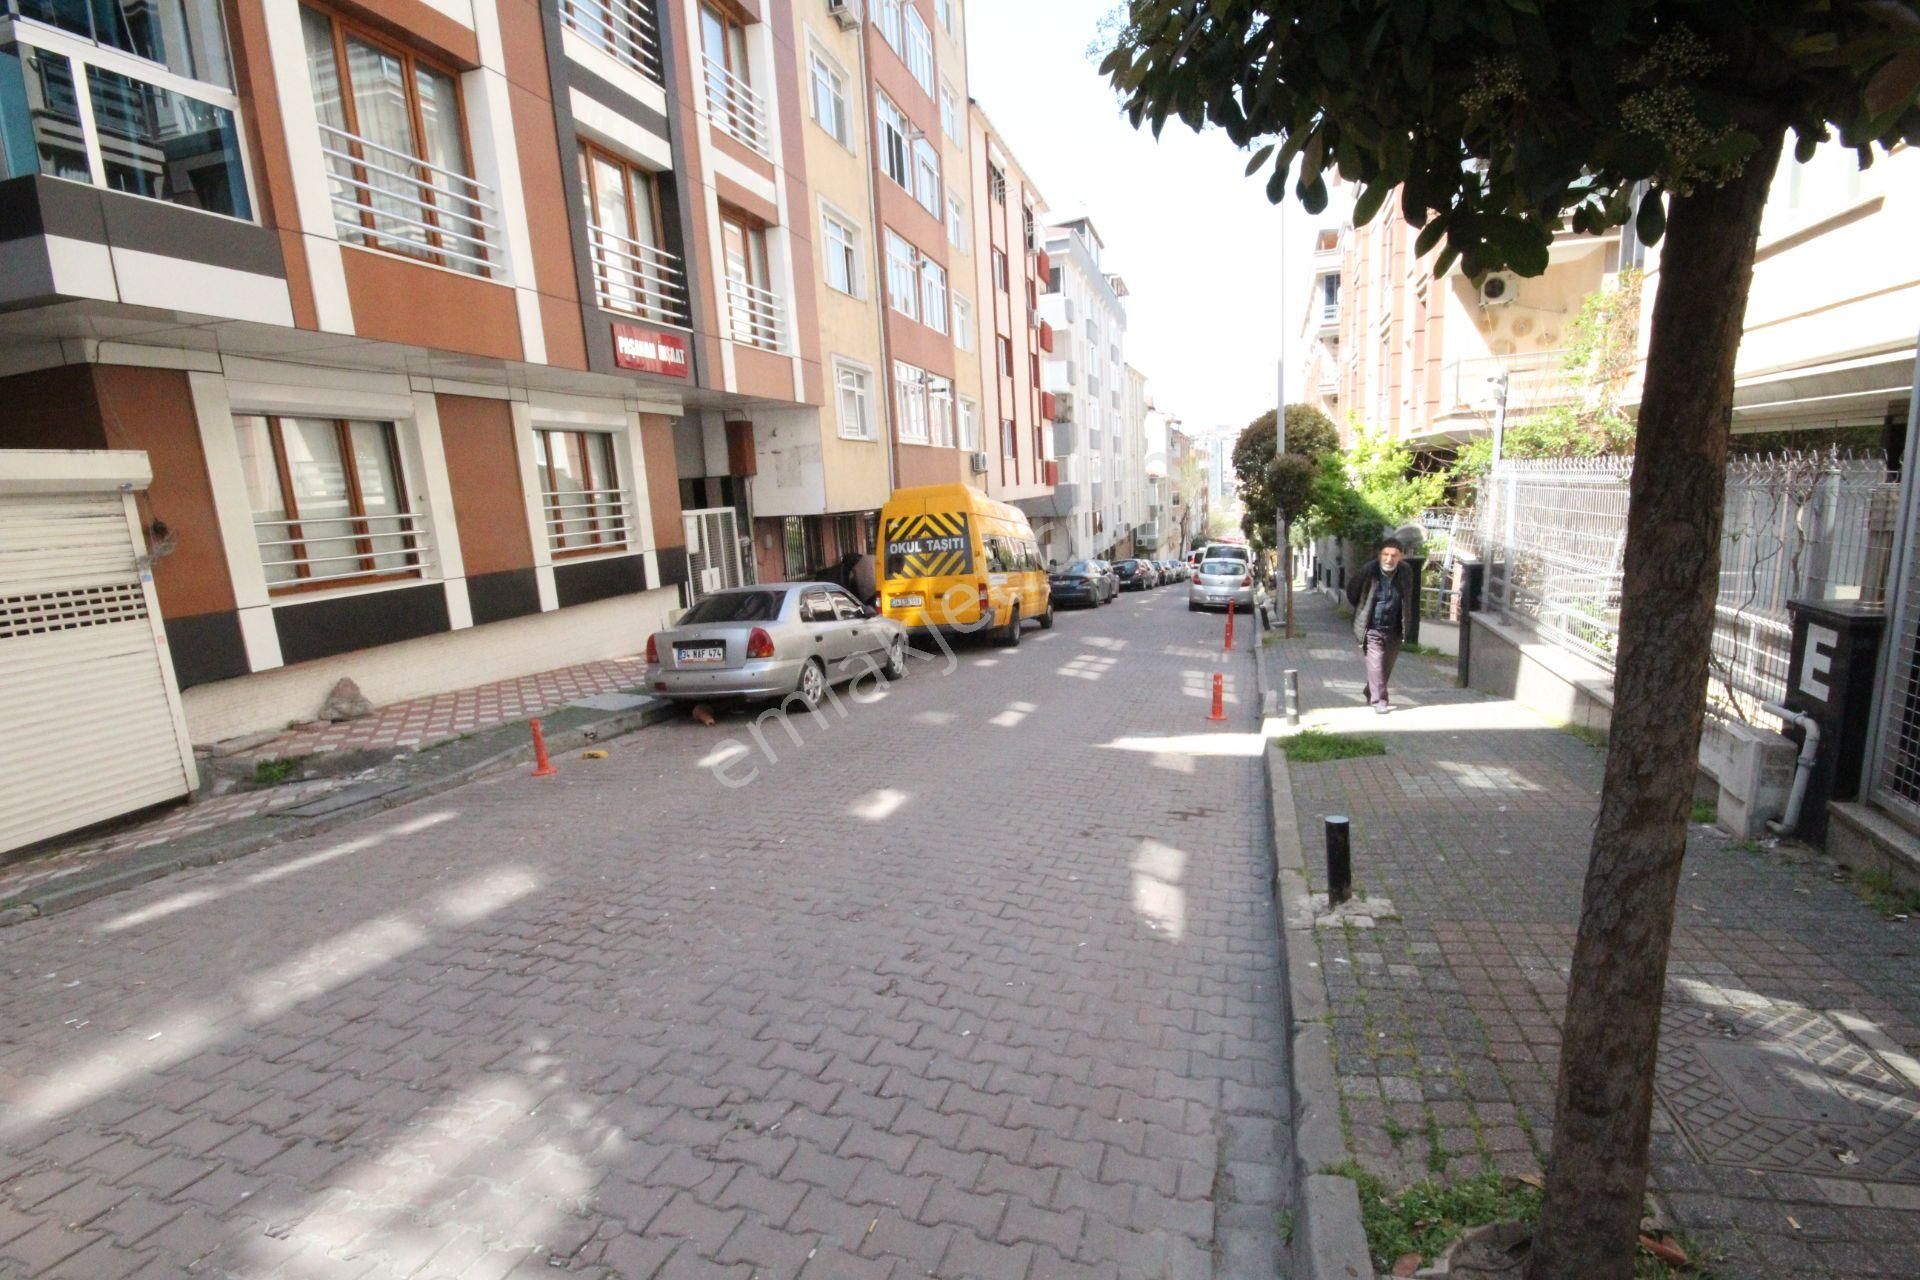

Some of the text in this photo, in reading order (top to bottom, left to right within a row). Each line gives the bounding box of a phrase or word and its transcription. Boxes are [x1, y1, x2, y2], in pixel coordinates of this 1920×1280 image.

[890, 537, 964, 555] OKUL TAŞITI
[1799, 622, 1839, 703] E
